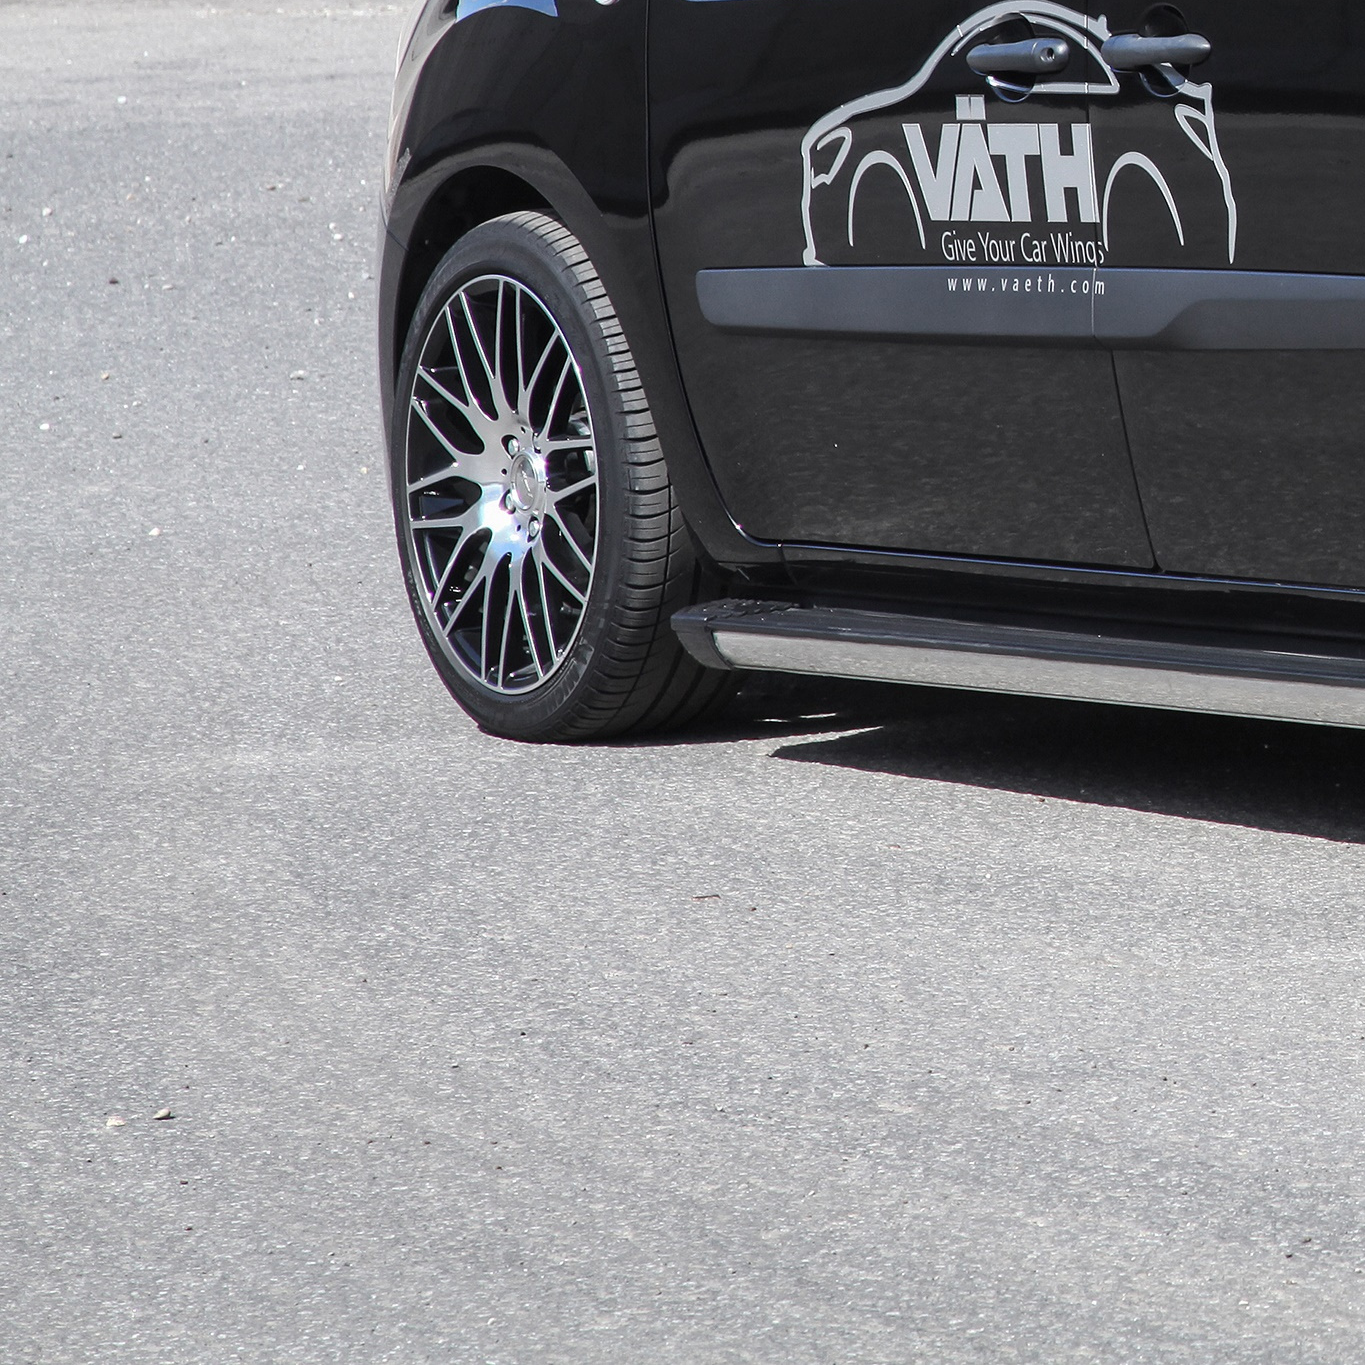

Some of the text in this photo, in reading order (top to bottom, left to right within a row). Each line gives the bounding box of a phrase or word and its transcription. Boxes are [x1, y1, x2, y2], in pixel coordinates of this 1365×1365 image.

[901, 94, 1100, 223] VÄTH
[941, 230, 1105, 267] Give Your Car Wings
[947, 273, 1106, 296] www.vaeth.com
